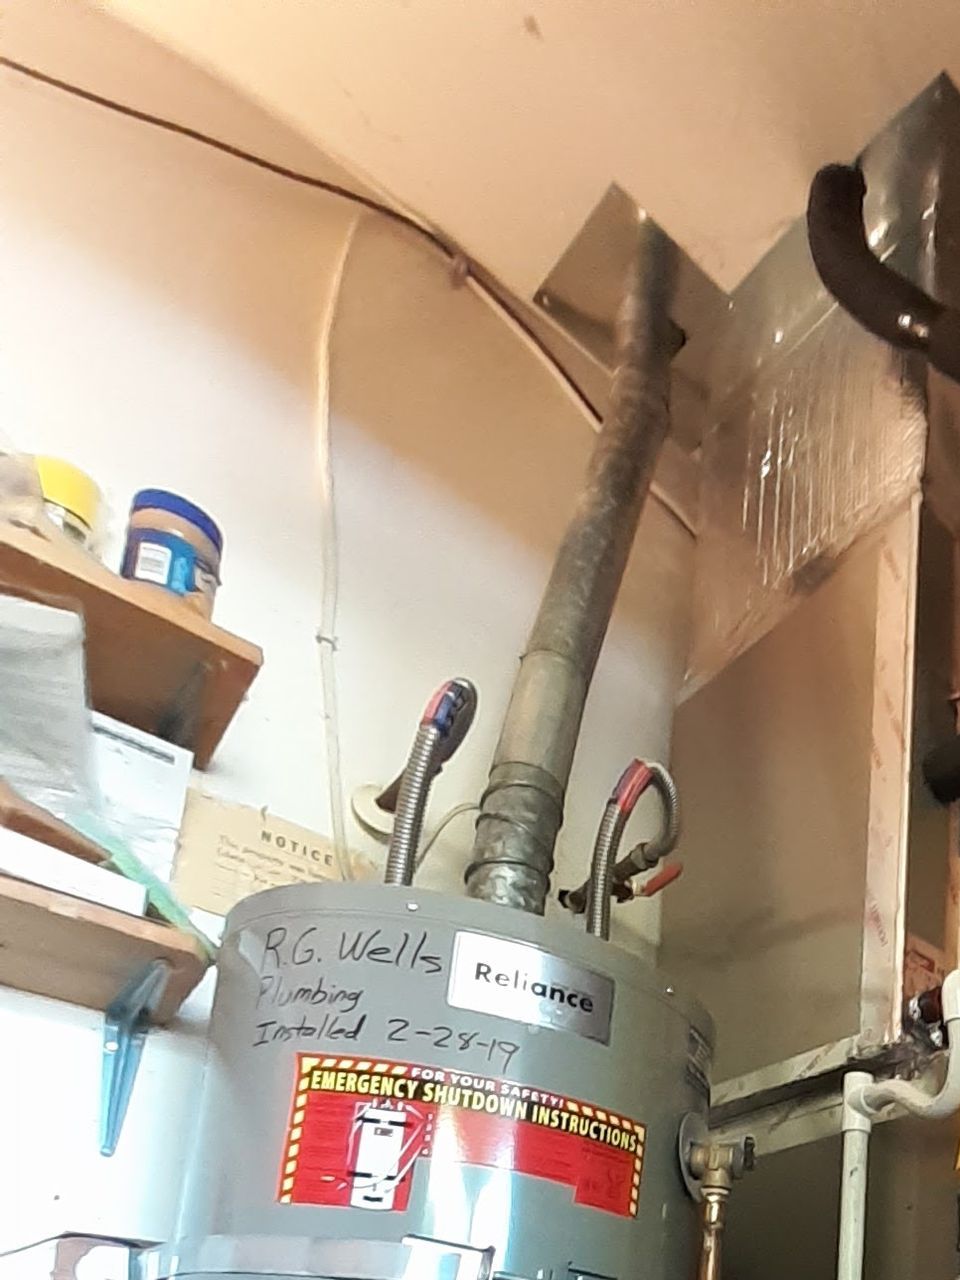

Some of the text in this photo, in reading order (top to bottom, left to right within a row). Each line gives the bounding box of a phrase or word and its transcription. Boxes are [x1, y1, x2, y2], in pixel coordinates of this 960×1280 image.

[260, 830, 334, 867] NOTICE
[261, 927, 443, 973] R.G. Wells
[255, 975, 365, 1013] Plumbing
[474, 962, 594, 1013] Reliance
[252, 1013, 520, 1074] Installed 2-28-19
[311, 1070, 637, 1151] EMERGENCY SHUTDOWN INSTRUCTIONS
[411, 1067, 564, 1108] FOR YOUR SAFETY!
